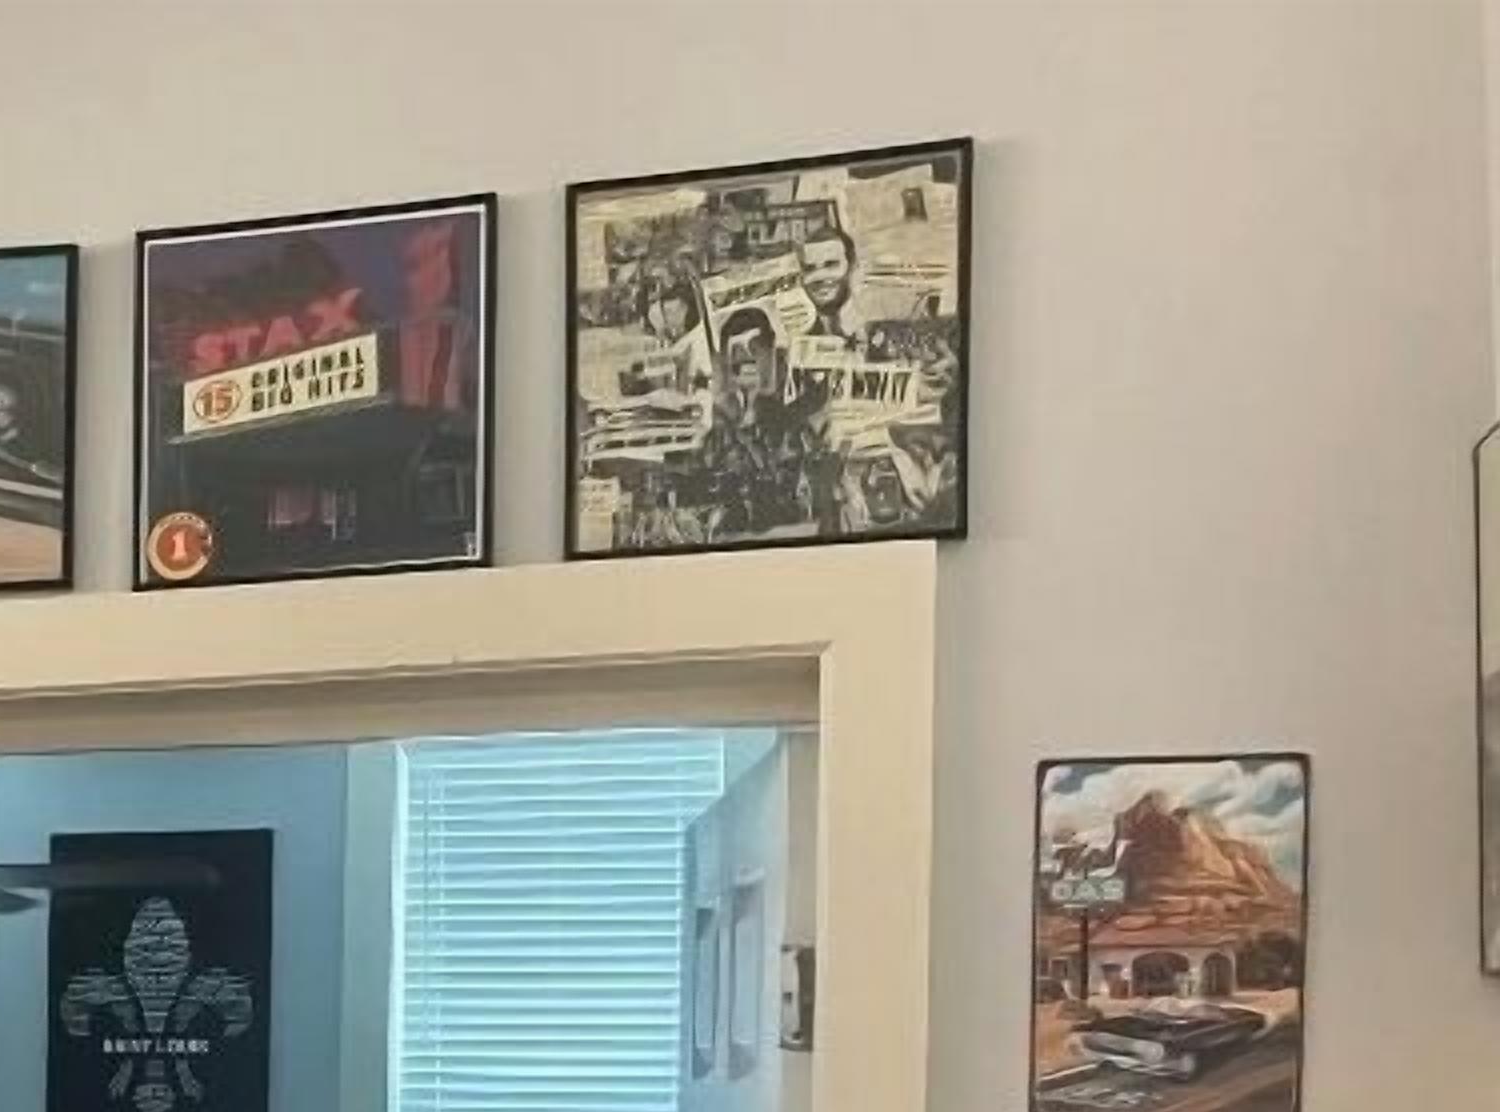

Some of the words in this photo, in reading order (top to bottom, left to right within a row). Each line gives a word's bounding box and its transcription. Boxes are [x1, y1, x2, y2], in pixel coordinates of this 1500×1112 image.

[188, 288, 363, 375] STAX
[307, 367, 365, 399] HITS
[171, 530, 187, 558] 1
